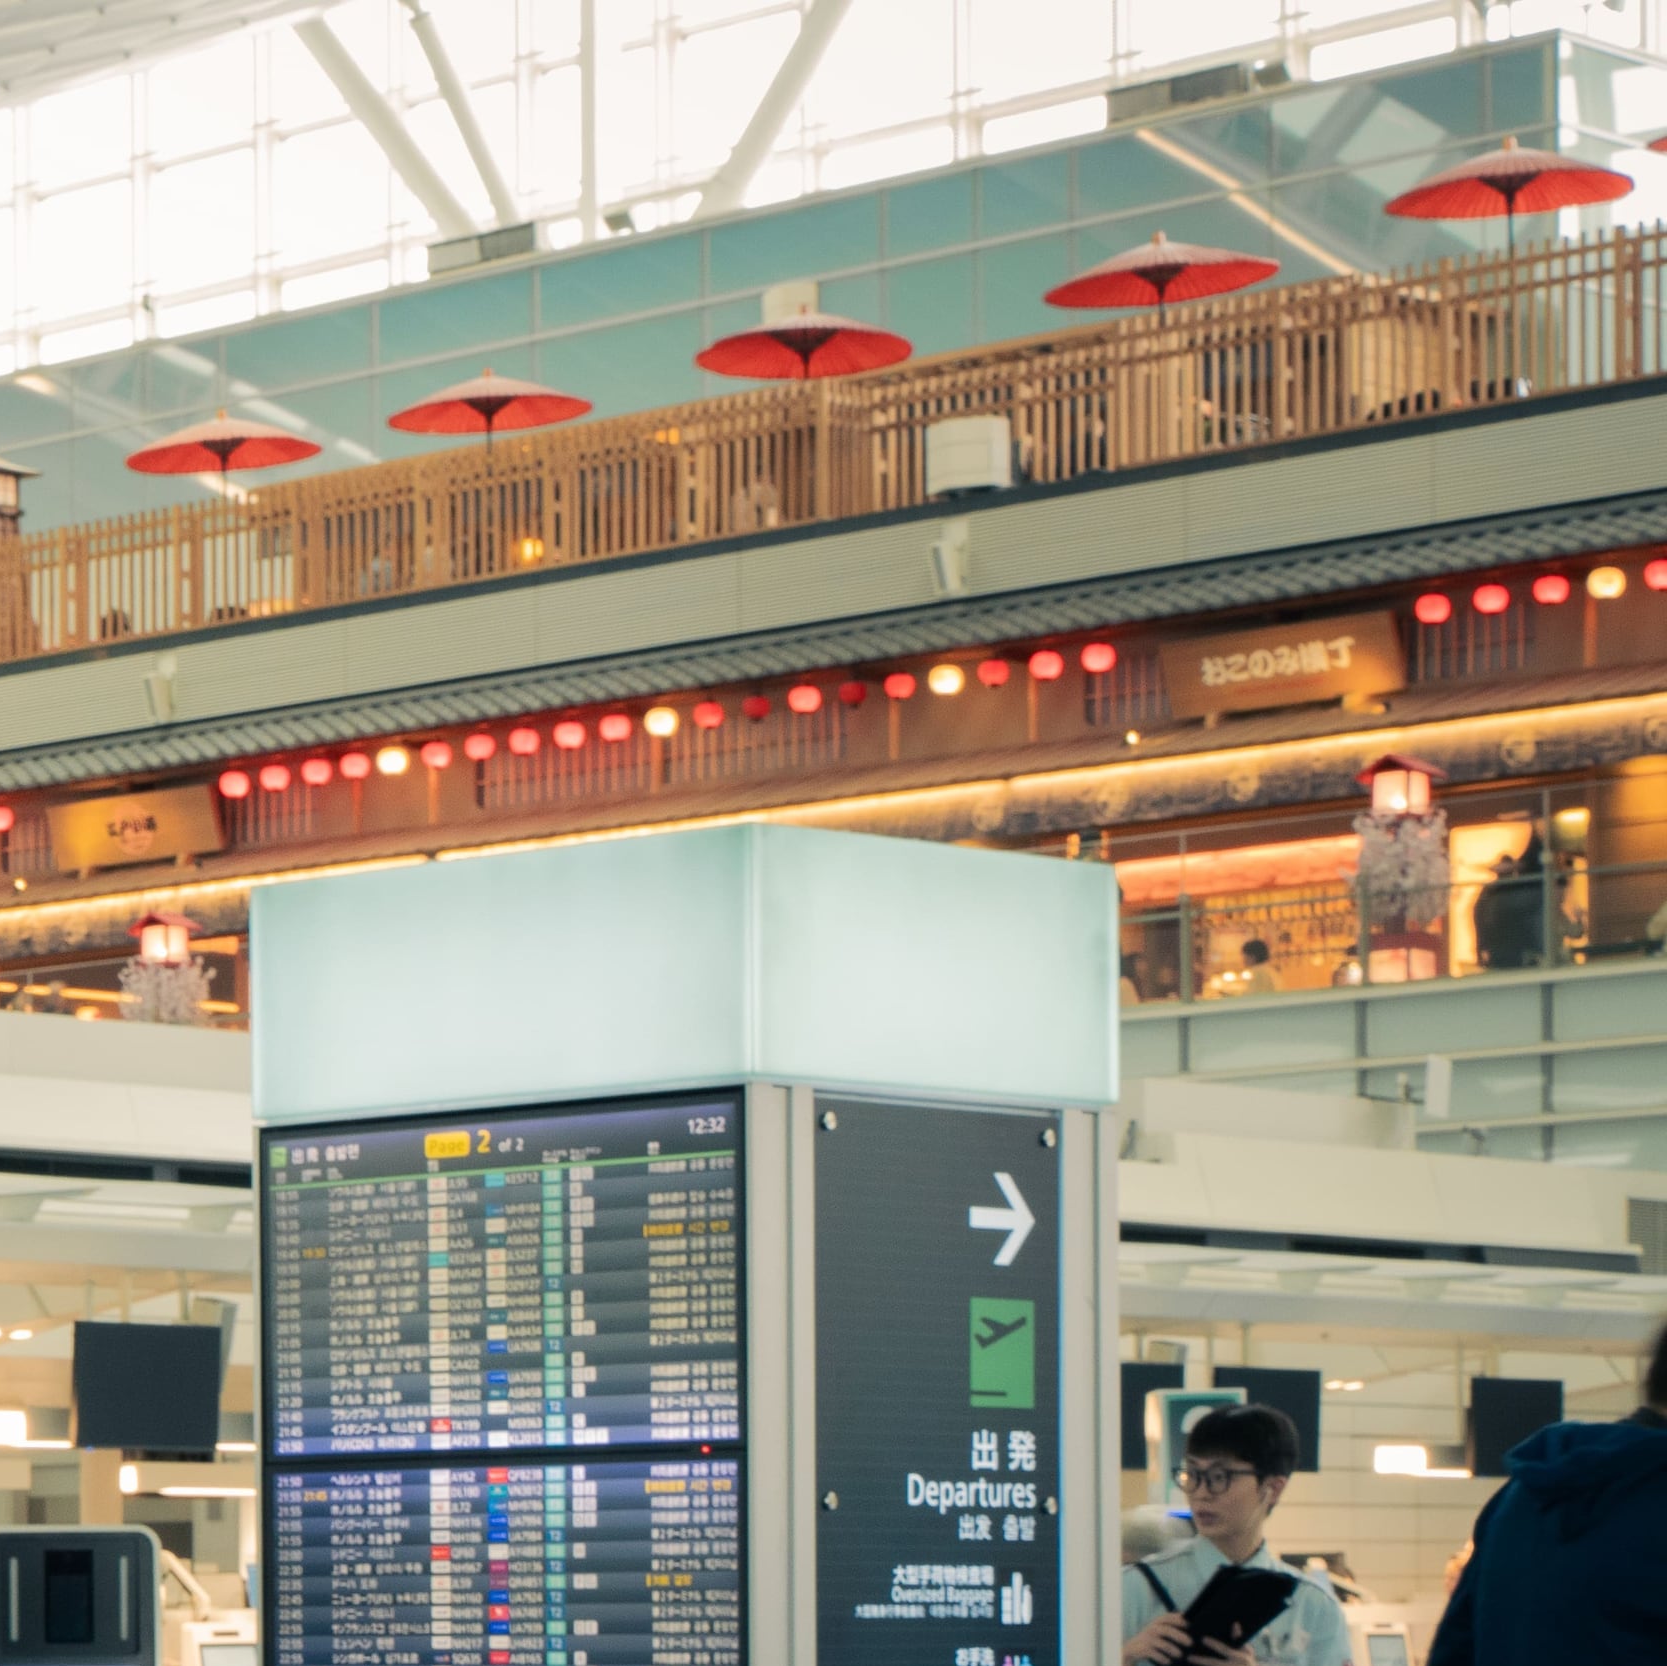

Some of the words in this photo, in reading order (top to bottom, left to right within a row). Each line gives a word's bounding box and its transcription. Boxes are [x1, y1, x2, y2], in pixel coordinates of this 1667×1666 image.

[687, 1116, 726, 1134] 12:32
[430, 1138, 465, 1153] Page
[477, 1129, 491, 1153] 2
[498, 1138, 512, 1152] of
[516, 1137, 524, 1152] 2
[971, 1429, 1037, 1471] 出発
[907, 1473, 1037, 1514] Departures
[959, 1514, 992, 1541] 出发
[947, 1586, 995, 1607] Baggage
